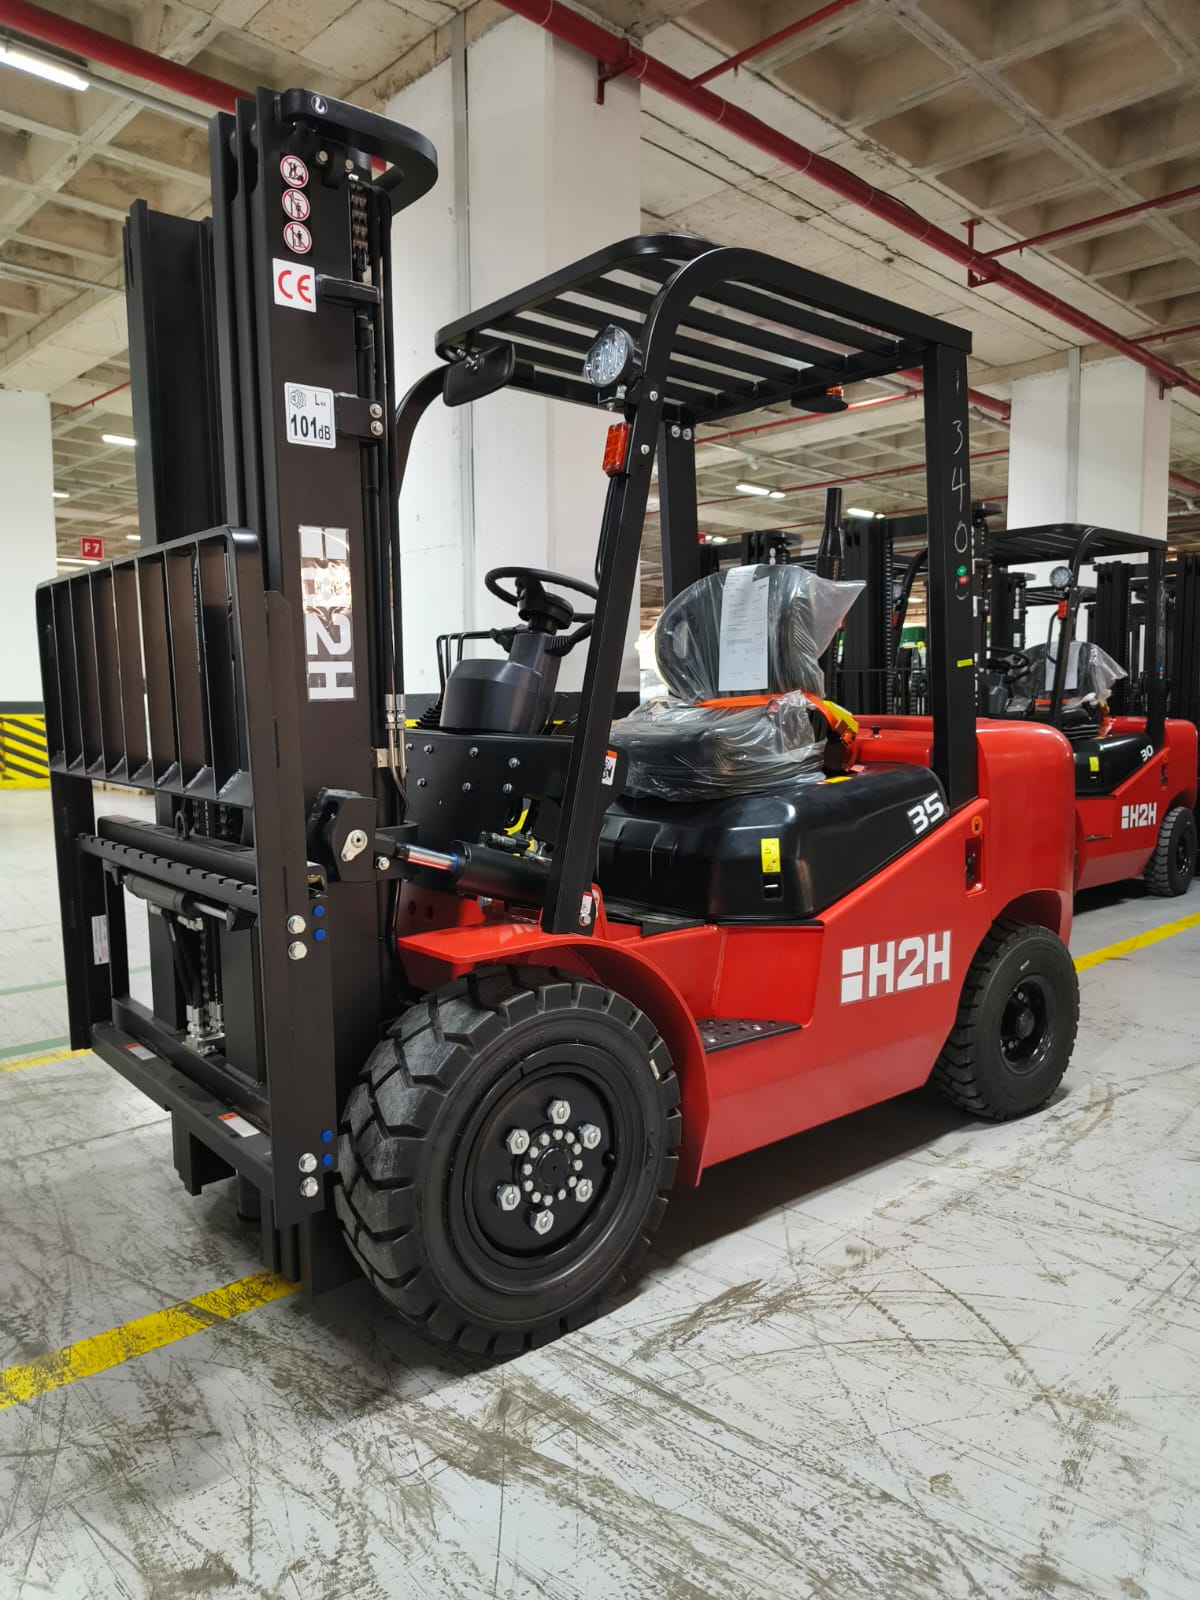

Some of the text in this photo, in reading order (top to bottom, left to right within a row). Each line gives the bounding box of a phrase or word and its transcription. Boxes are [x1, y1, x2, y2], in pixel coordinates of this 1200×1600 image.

[277, 269, 313, 304] CE
[1140, 744, 1154, 762] 30
[907, 791, 945, 835] 35
[1129, 802, 1158, 829] H2H
[868, 930, 951, 998] H2H
